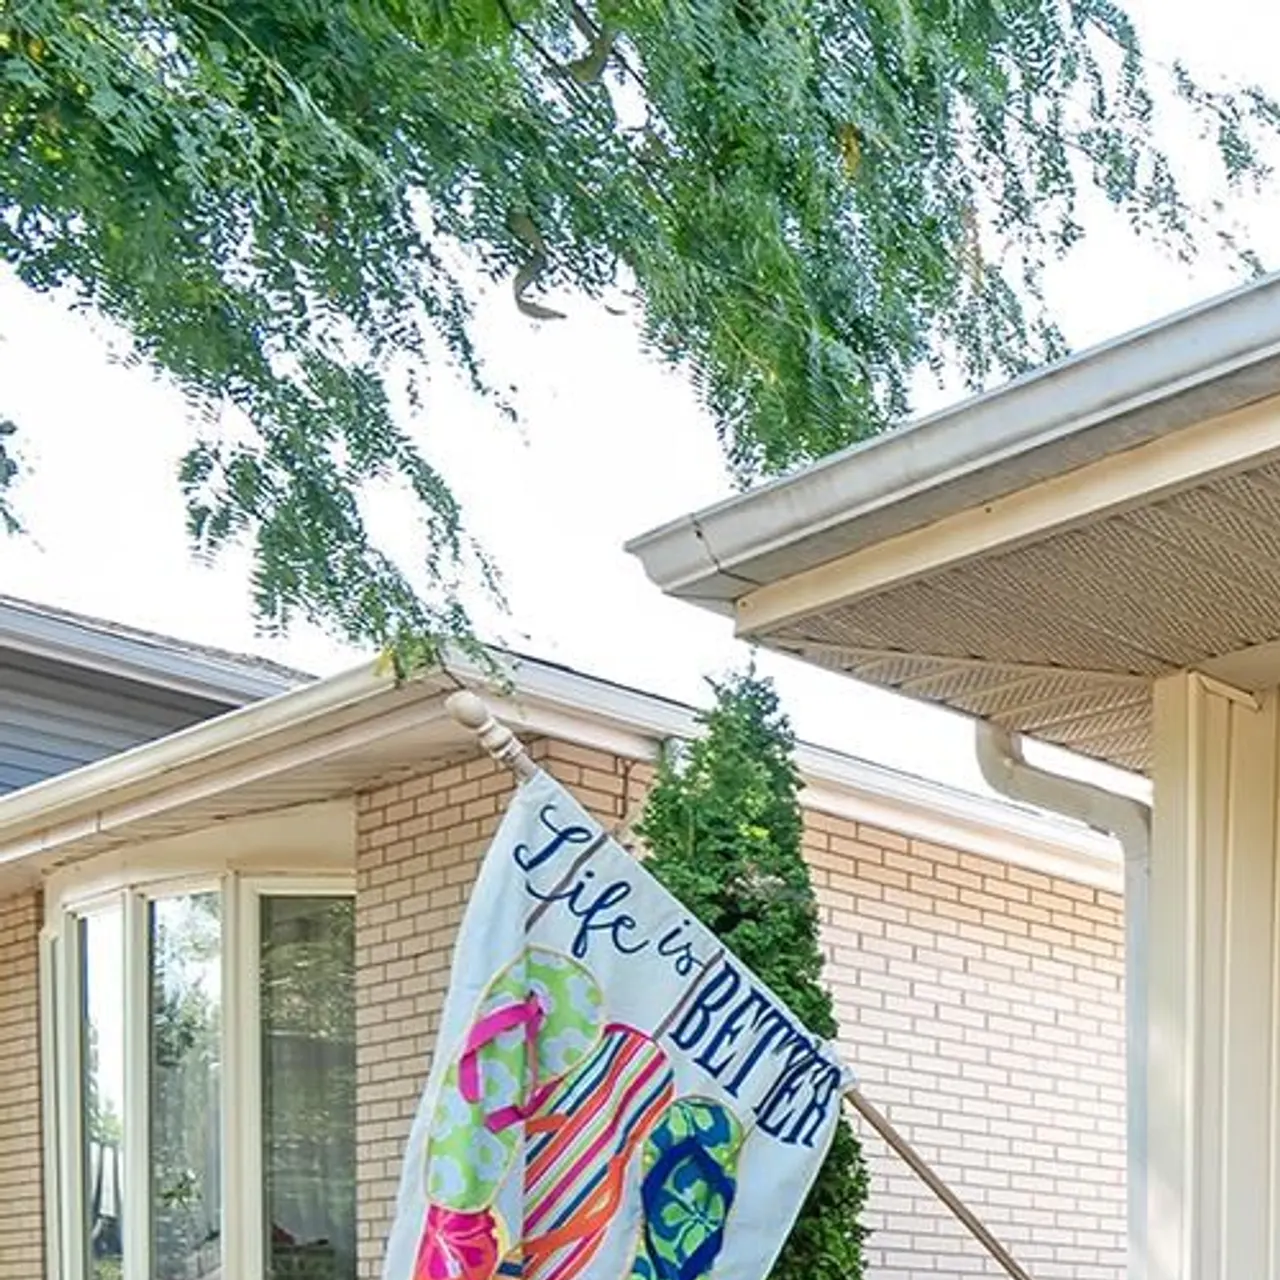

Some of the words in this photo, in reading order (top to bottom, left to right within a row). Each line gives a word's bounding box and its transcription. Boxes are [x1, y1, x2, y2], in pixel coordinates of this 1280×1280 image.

[514, 804, 650, 958] Life
[657, 919, 705, 976] is
[669, 960, 842, 1147] BETTER
